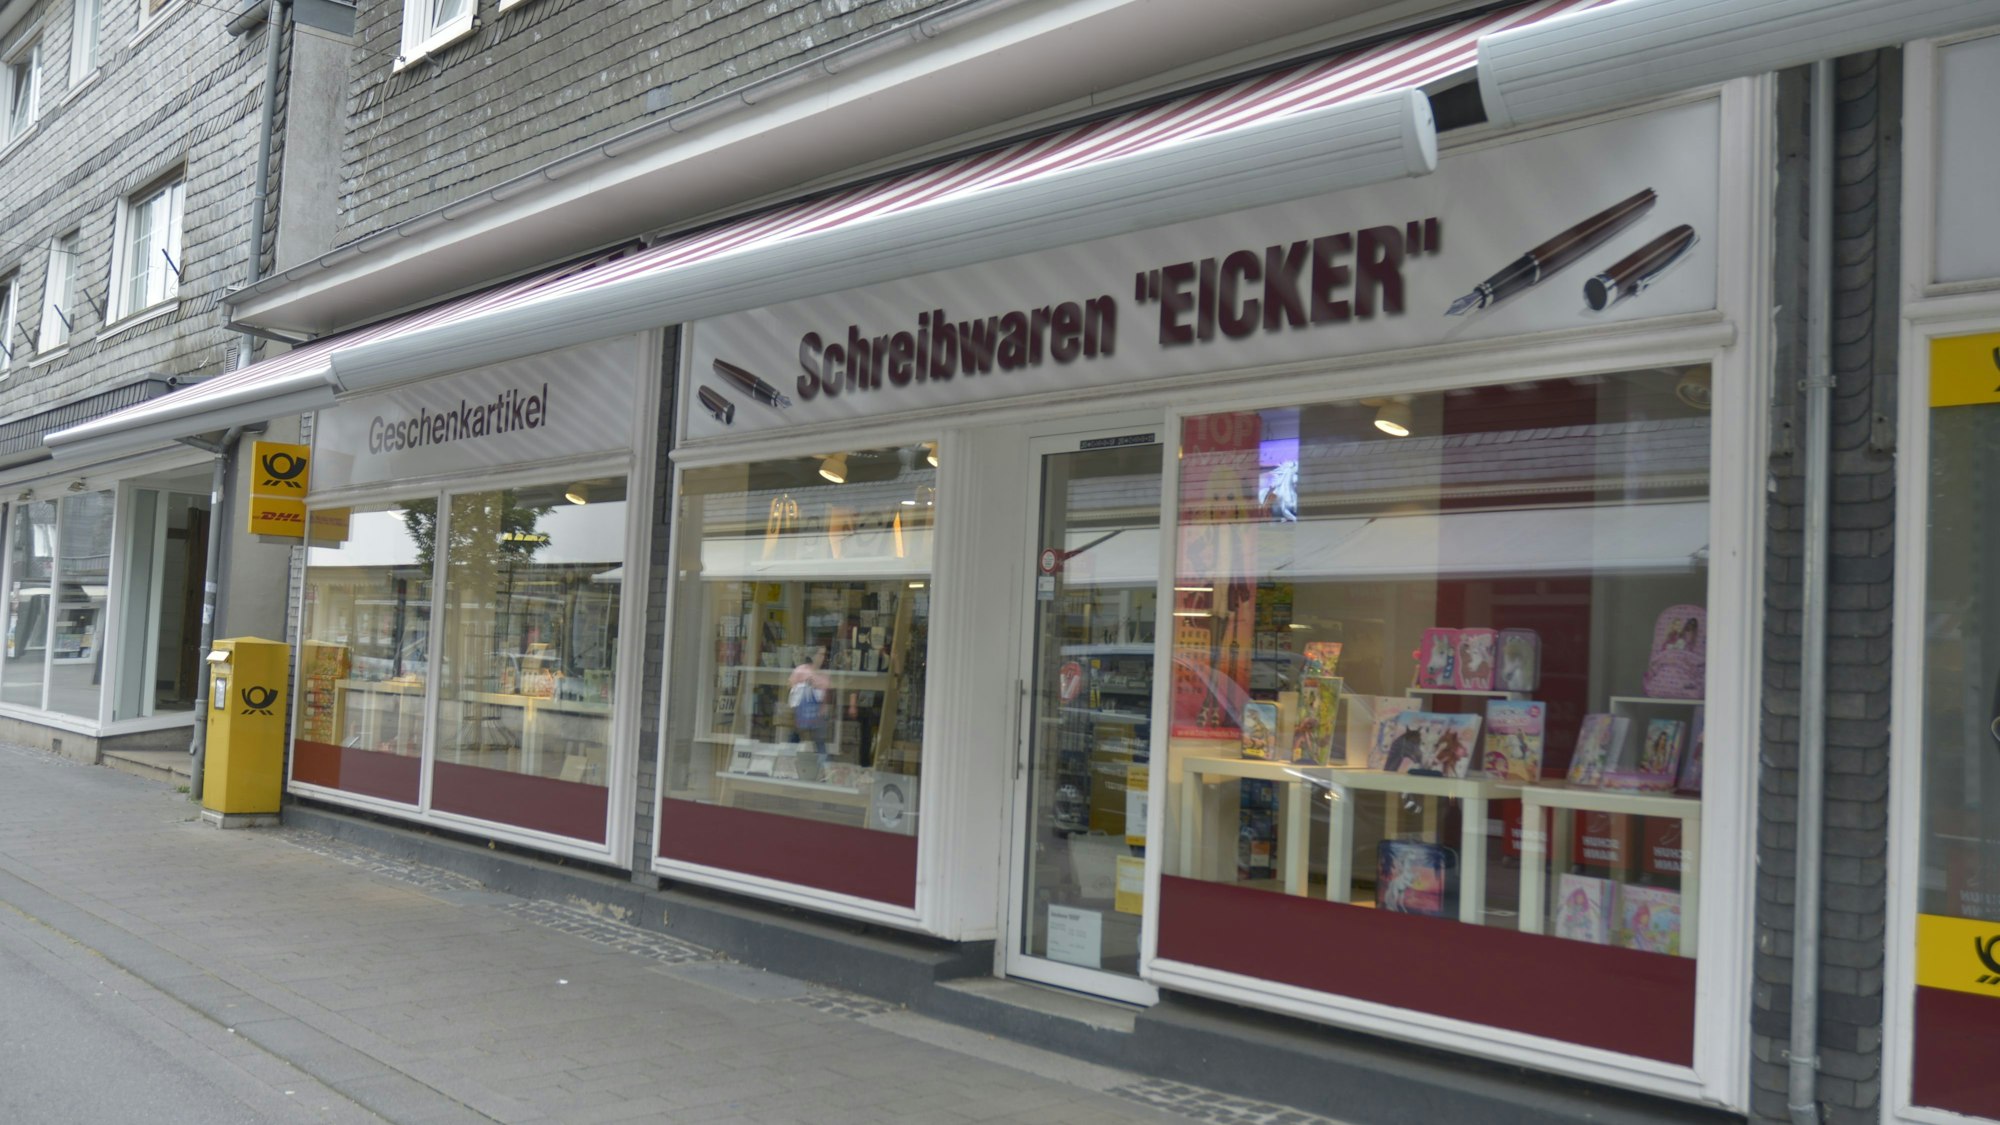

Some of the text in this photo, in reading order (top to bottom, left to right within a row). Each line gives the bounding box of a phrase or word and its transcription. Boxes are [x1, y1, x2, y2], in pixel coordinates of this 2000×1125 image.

[797, 217, 1438, 399] Schreibwaren "EICKER"
[368, 383, 548, 455] Geschenkartikel
[260, 511, 302, 523] DHL
